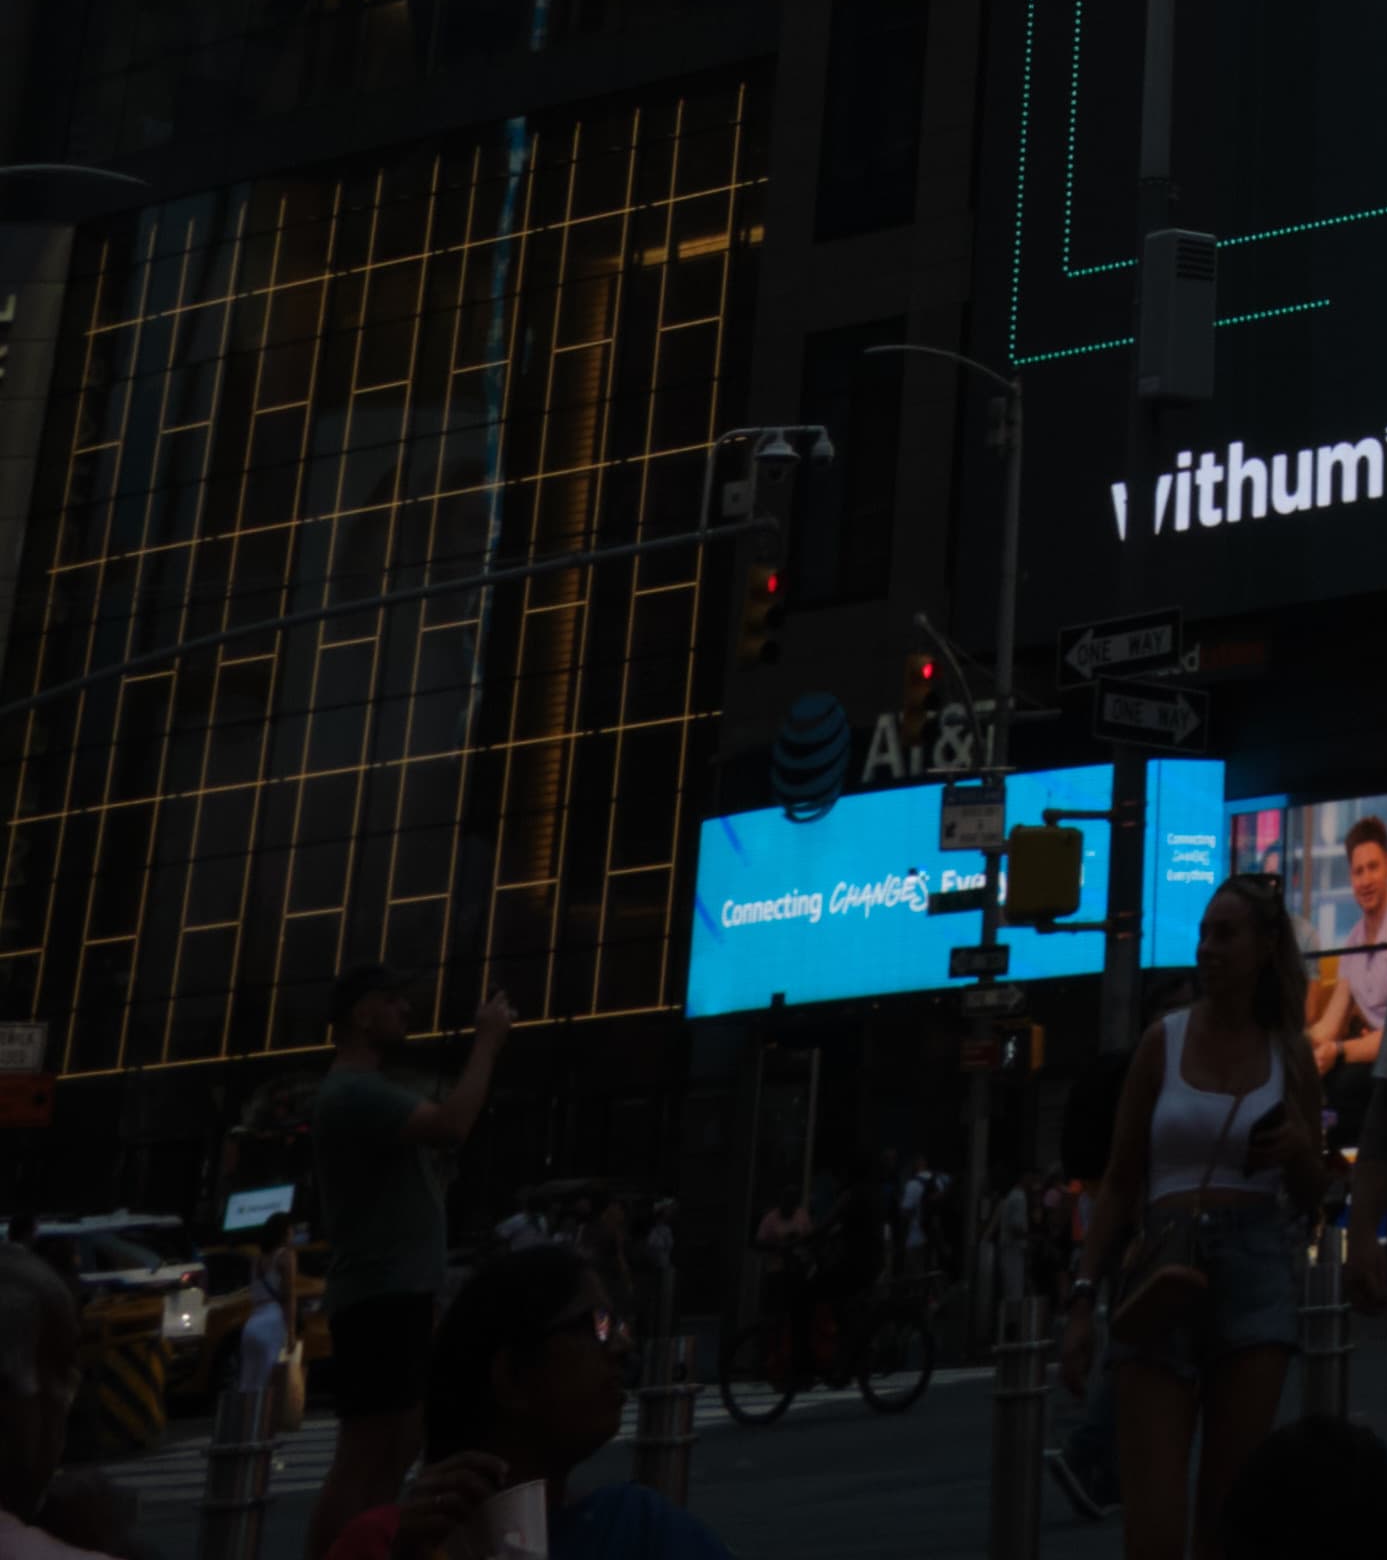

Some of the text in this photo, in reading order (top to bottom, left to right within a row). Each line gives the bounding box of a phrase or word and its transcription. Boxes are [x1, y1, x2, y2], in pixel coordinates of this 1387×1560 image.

[1078, 629, 1166, 665] ONE WAY
[1112, 698, 1190, 731] ONE WAY
[721, 889, 823, 928] Connecting
